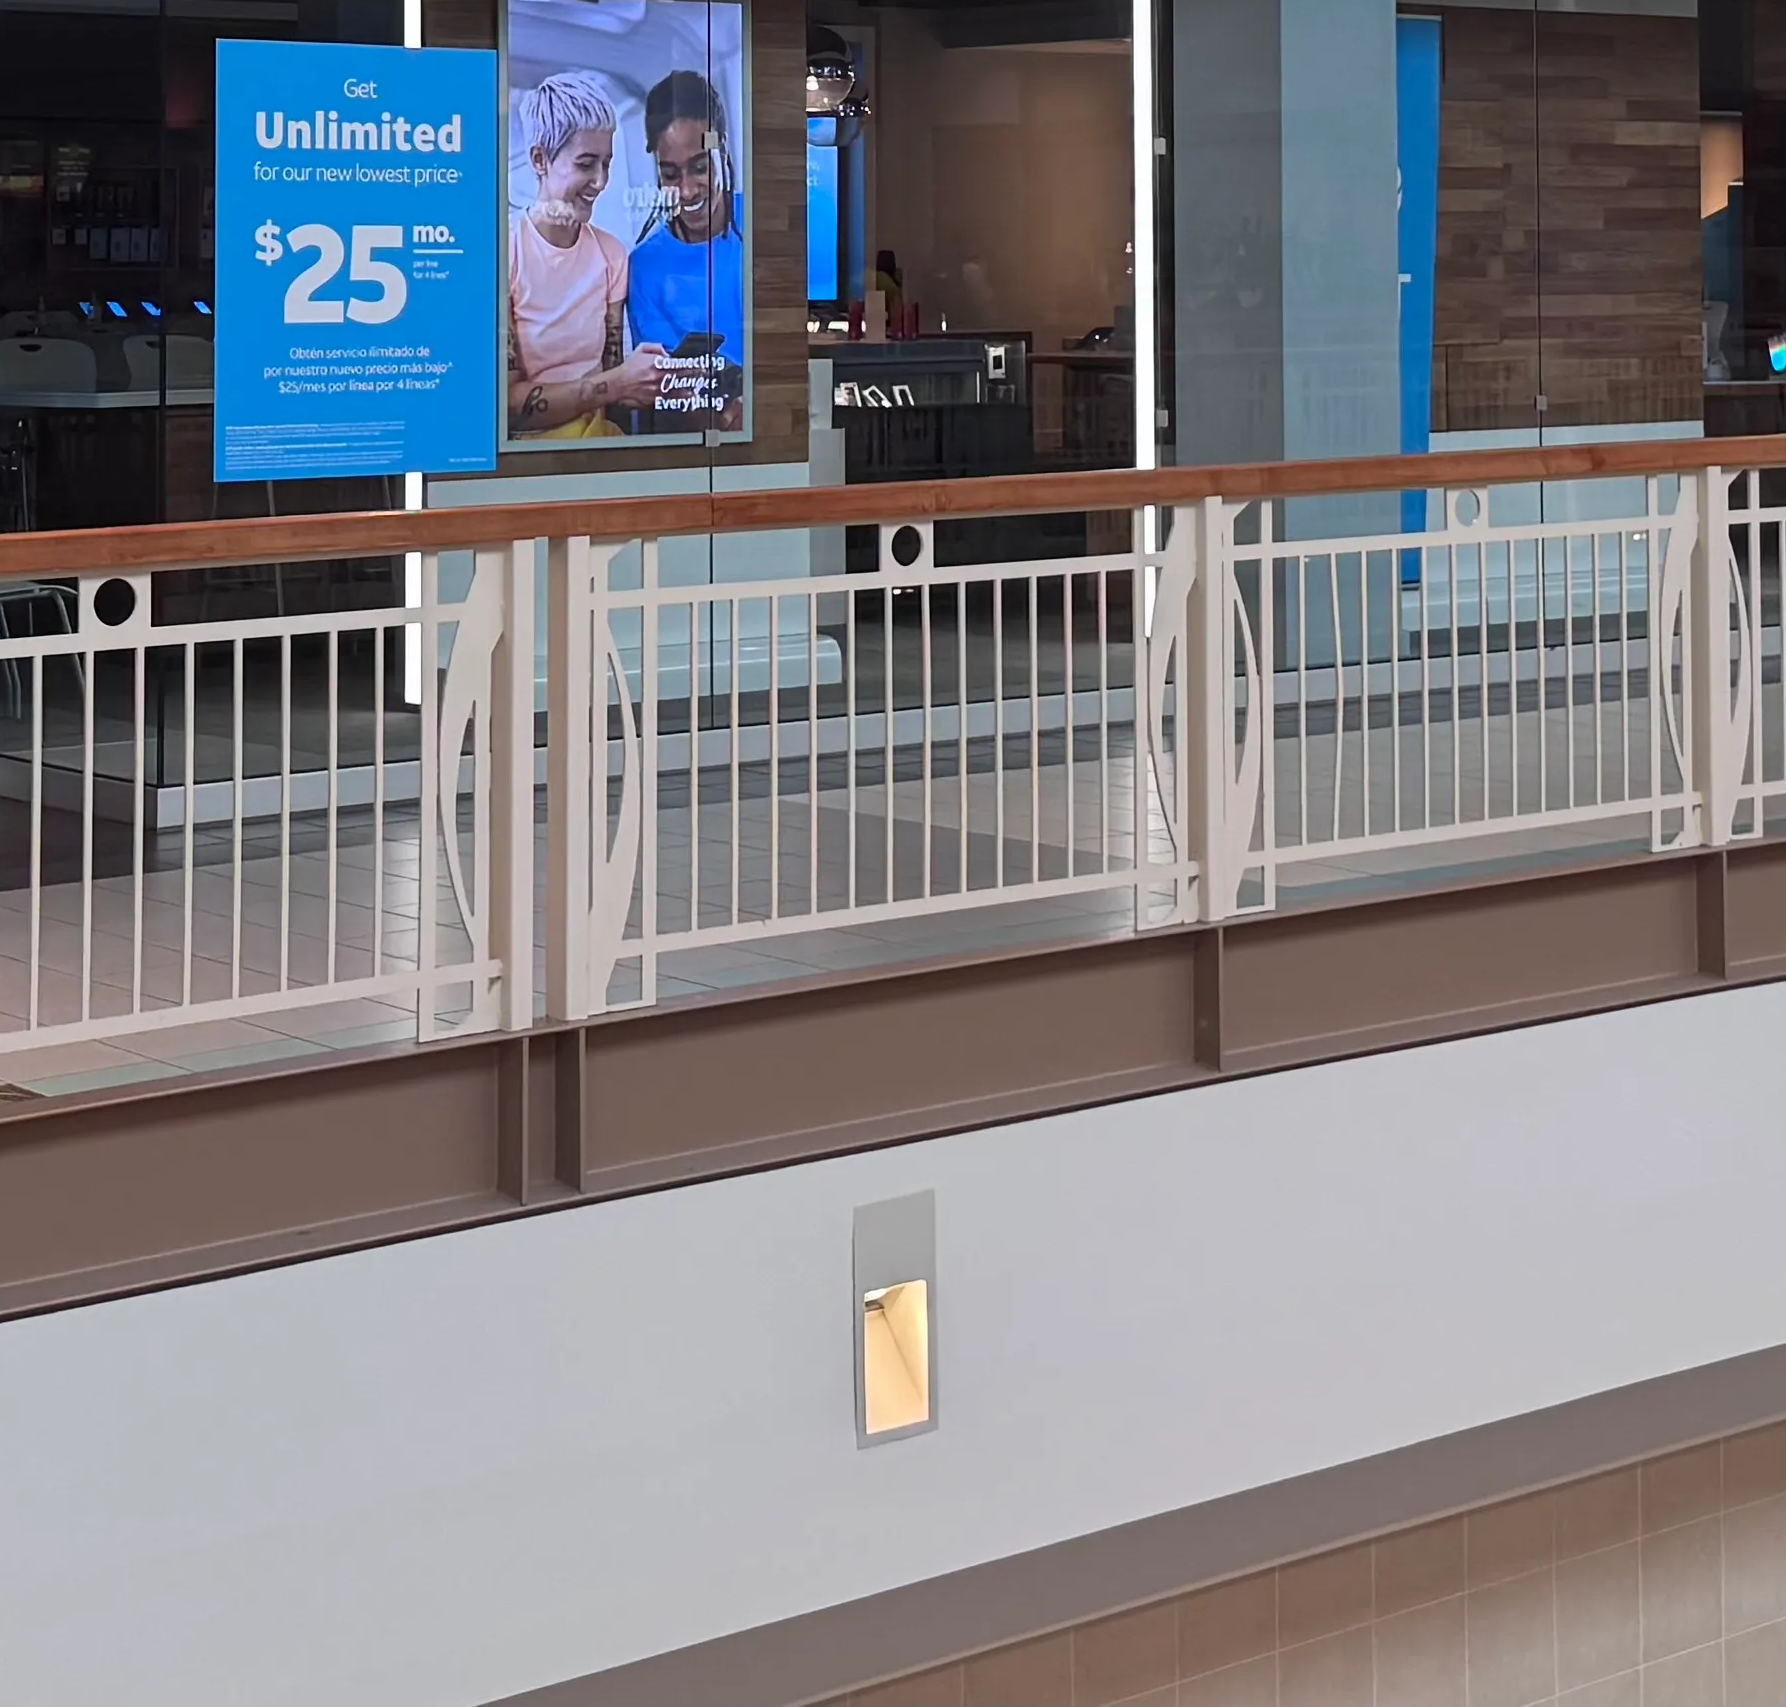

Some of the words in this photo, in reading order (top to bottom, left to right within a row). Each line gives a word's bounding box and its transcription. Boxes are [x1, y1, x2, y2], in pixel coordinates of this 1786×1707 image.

[344, 78, 377, 98] Get
[255, 110, 461, 152] Unlimited
[254, 161, 279, 181] for
[283, 166, 312, 181] our
[316, 167, 352, 182] new
[356, 163, 410, 183] lowest
[255, 219, 407, 324] $25
[413, 224, 455, 243] mo.
[325, 347, 367, 359] servicio
[416, 345, 430, 358] de
[264, 367, 282, 379] por
[285, 366, 328, 376] nuestro
[329, 365, 364, 375] nuevo
[365, 363, 398, 376] precio
[279, 380, 327, 394] $25/mes
[328, 382, 346, 394] por
[376, 381, 394, 393] por
